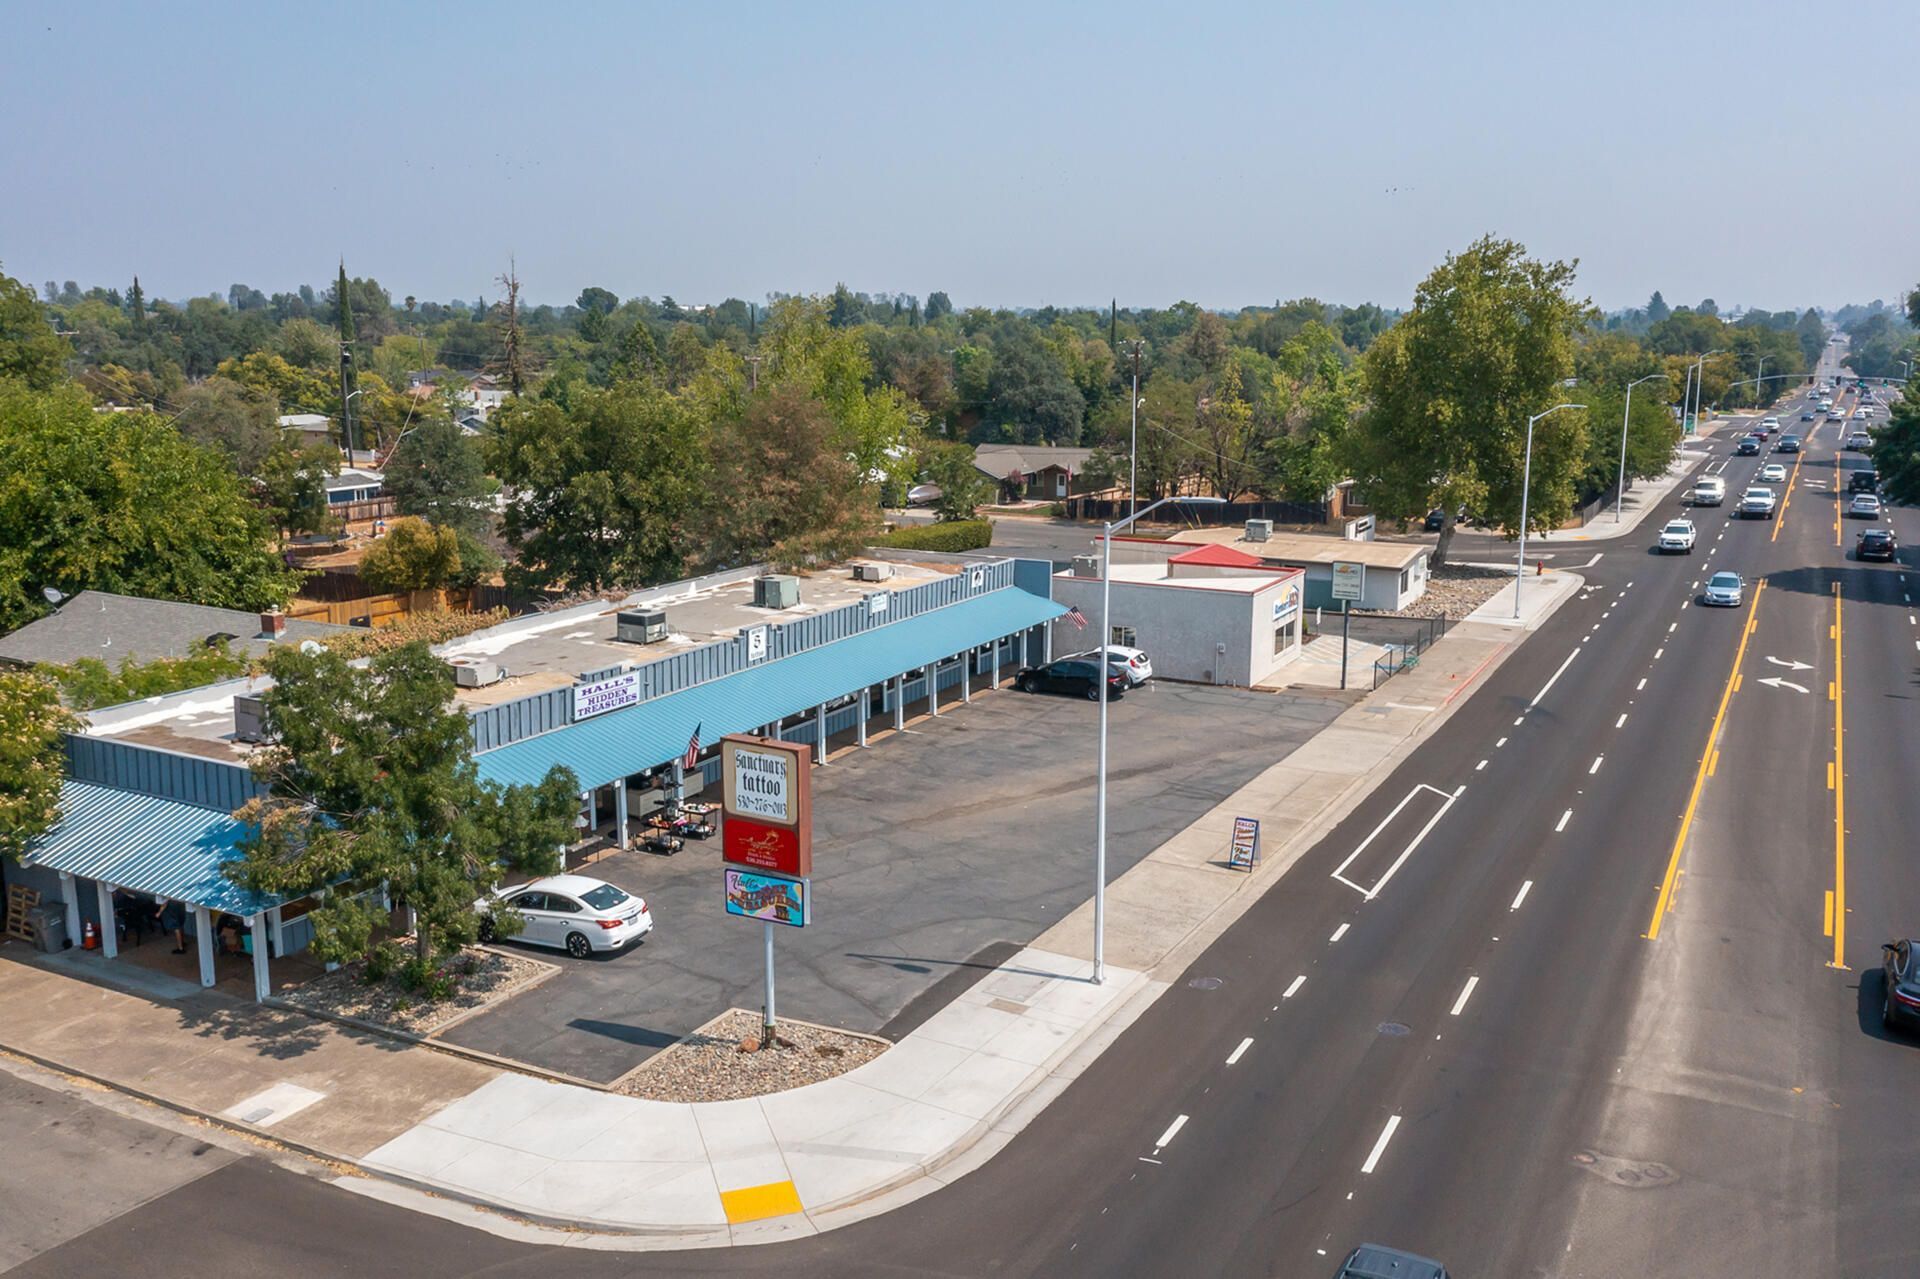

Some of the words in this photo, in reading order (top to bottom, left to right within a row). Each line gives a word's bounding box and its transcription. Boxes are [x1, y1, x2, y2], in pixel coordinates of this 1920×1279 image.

[581, 675, 634, 696] HALL'S
[587, 687, 628, 706] HIDDEN
[577, 692, 638, 717] TREASURES
[742, 771, 781, 797] tattoo
